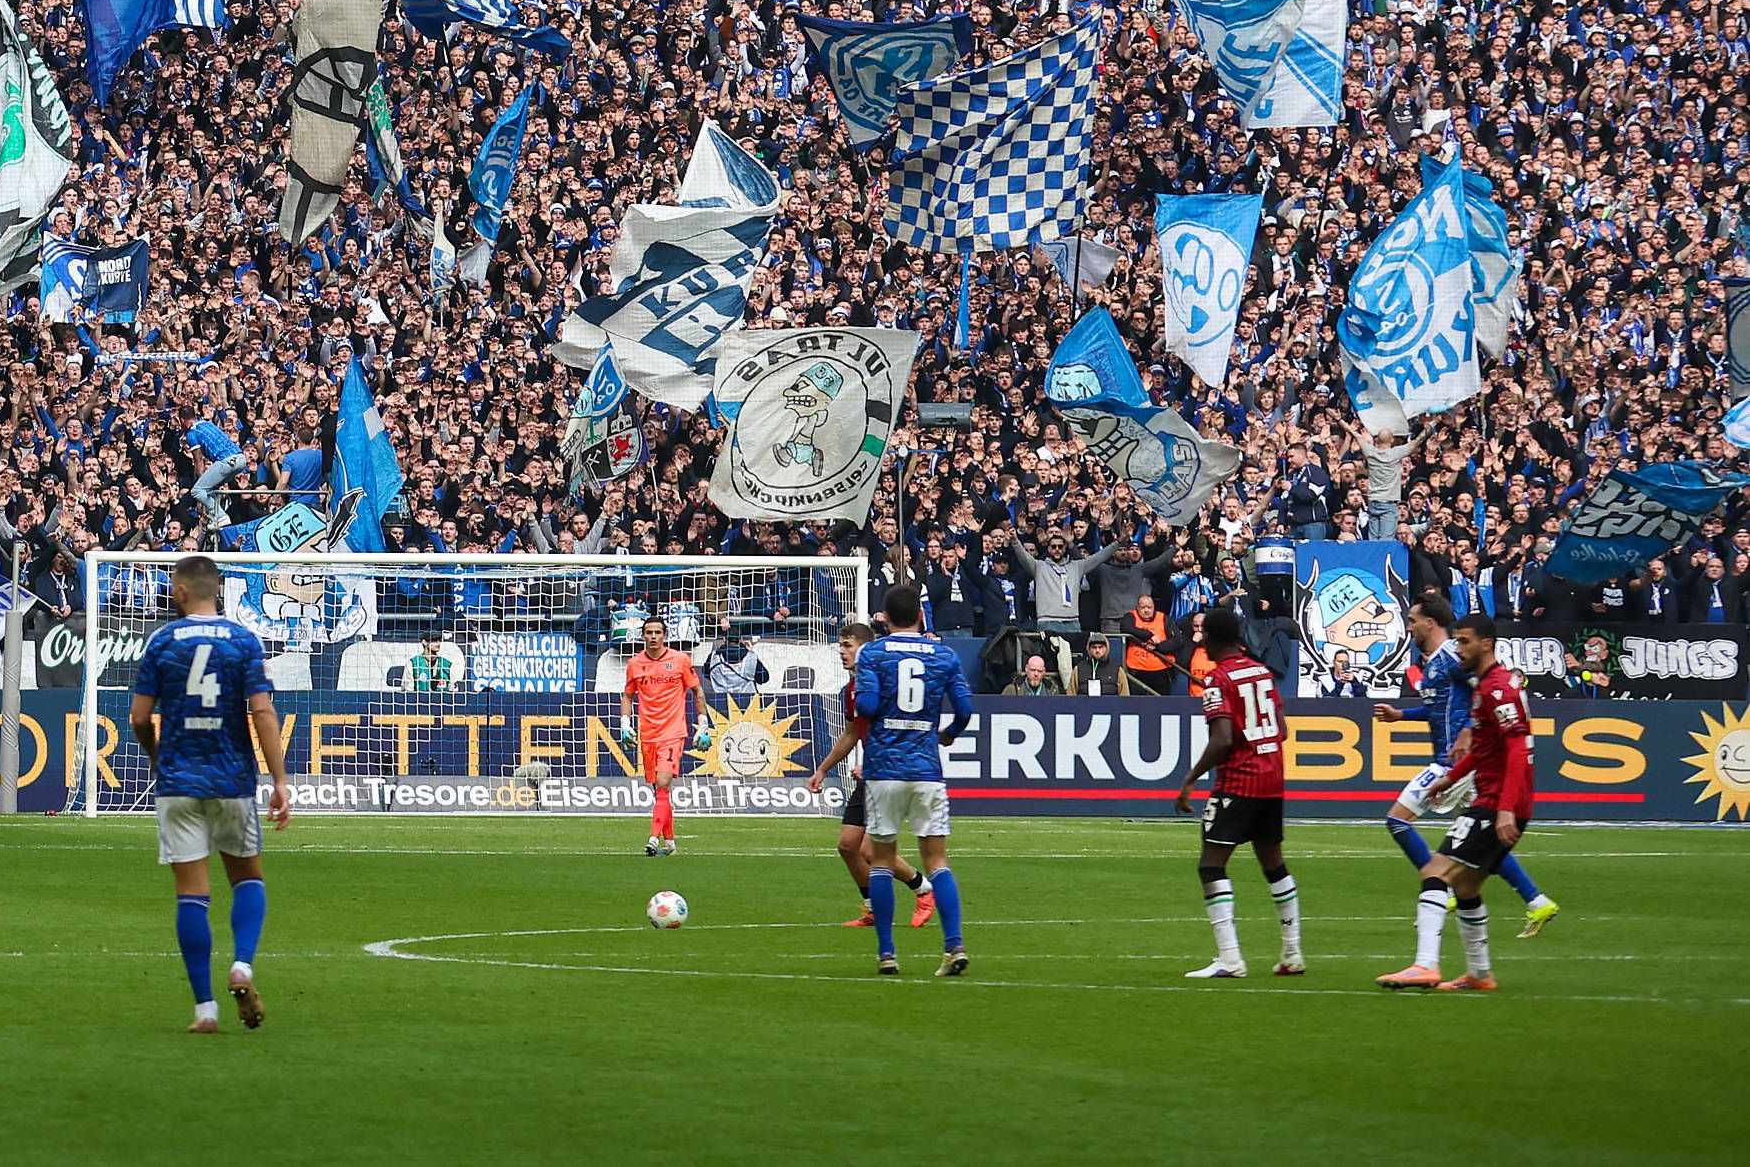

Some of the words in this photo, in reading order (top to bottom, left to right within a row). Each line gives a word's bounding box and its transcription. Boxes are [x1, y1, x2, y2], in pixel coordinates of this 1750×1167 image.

[98, 256, 132, 273] NORD
[98, 270, 132, 286] KURVE
[41, 624, 148, 680] Origin
[472, 633, 577, 658] FUSSBALLCLUB
[1496, 637, 1567, 679] RLER
[1618, 636, 1740, 680] JUNGS
[186, 644, 222, 708] 4
[472, 656, 577, 679] GELSENKIRCHEN
[649, 674, 676, 686] heise
[896, 657, 926, 713] 6
[1237, 678, 1280, 742] 15
[665, 747, 675, 762] 1
[940, 714, 1210, 780] ERKU
[1415, 768, 1437, 788] 19
